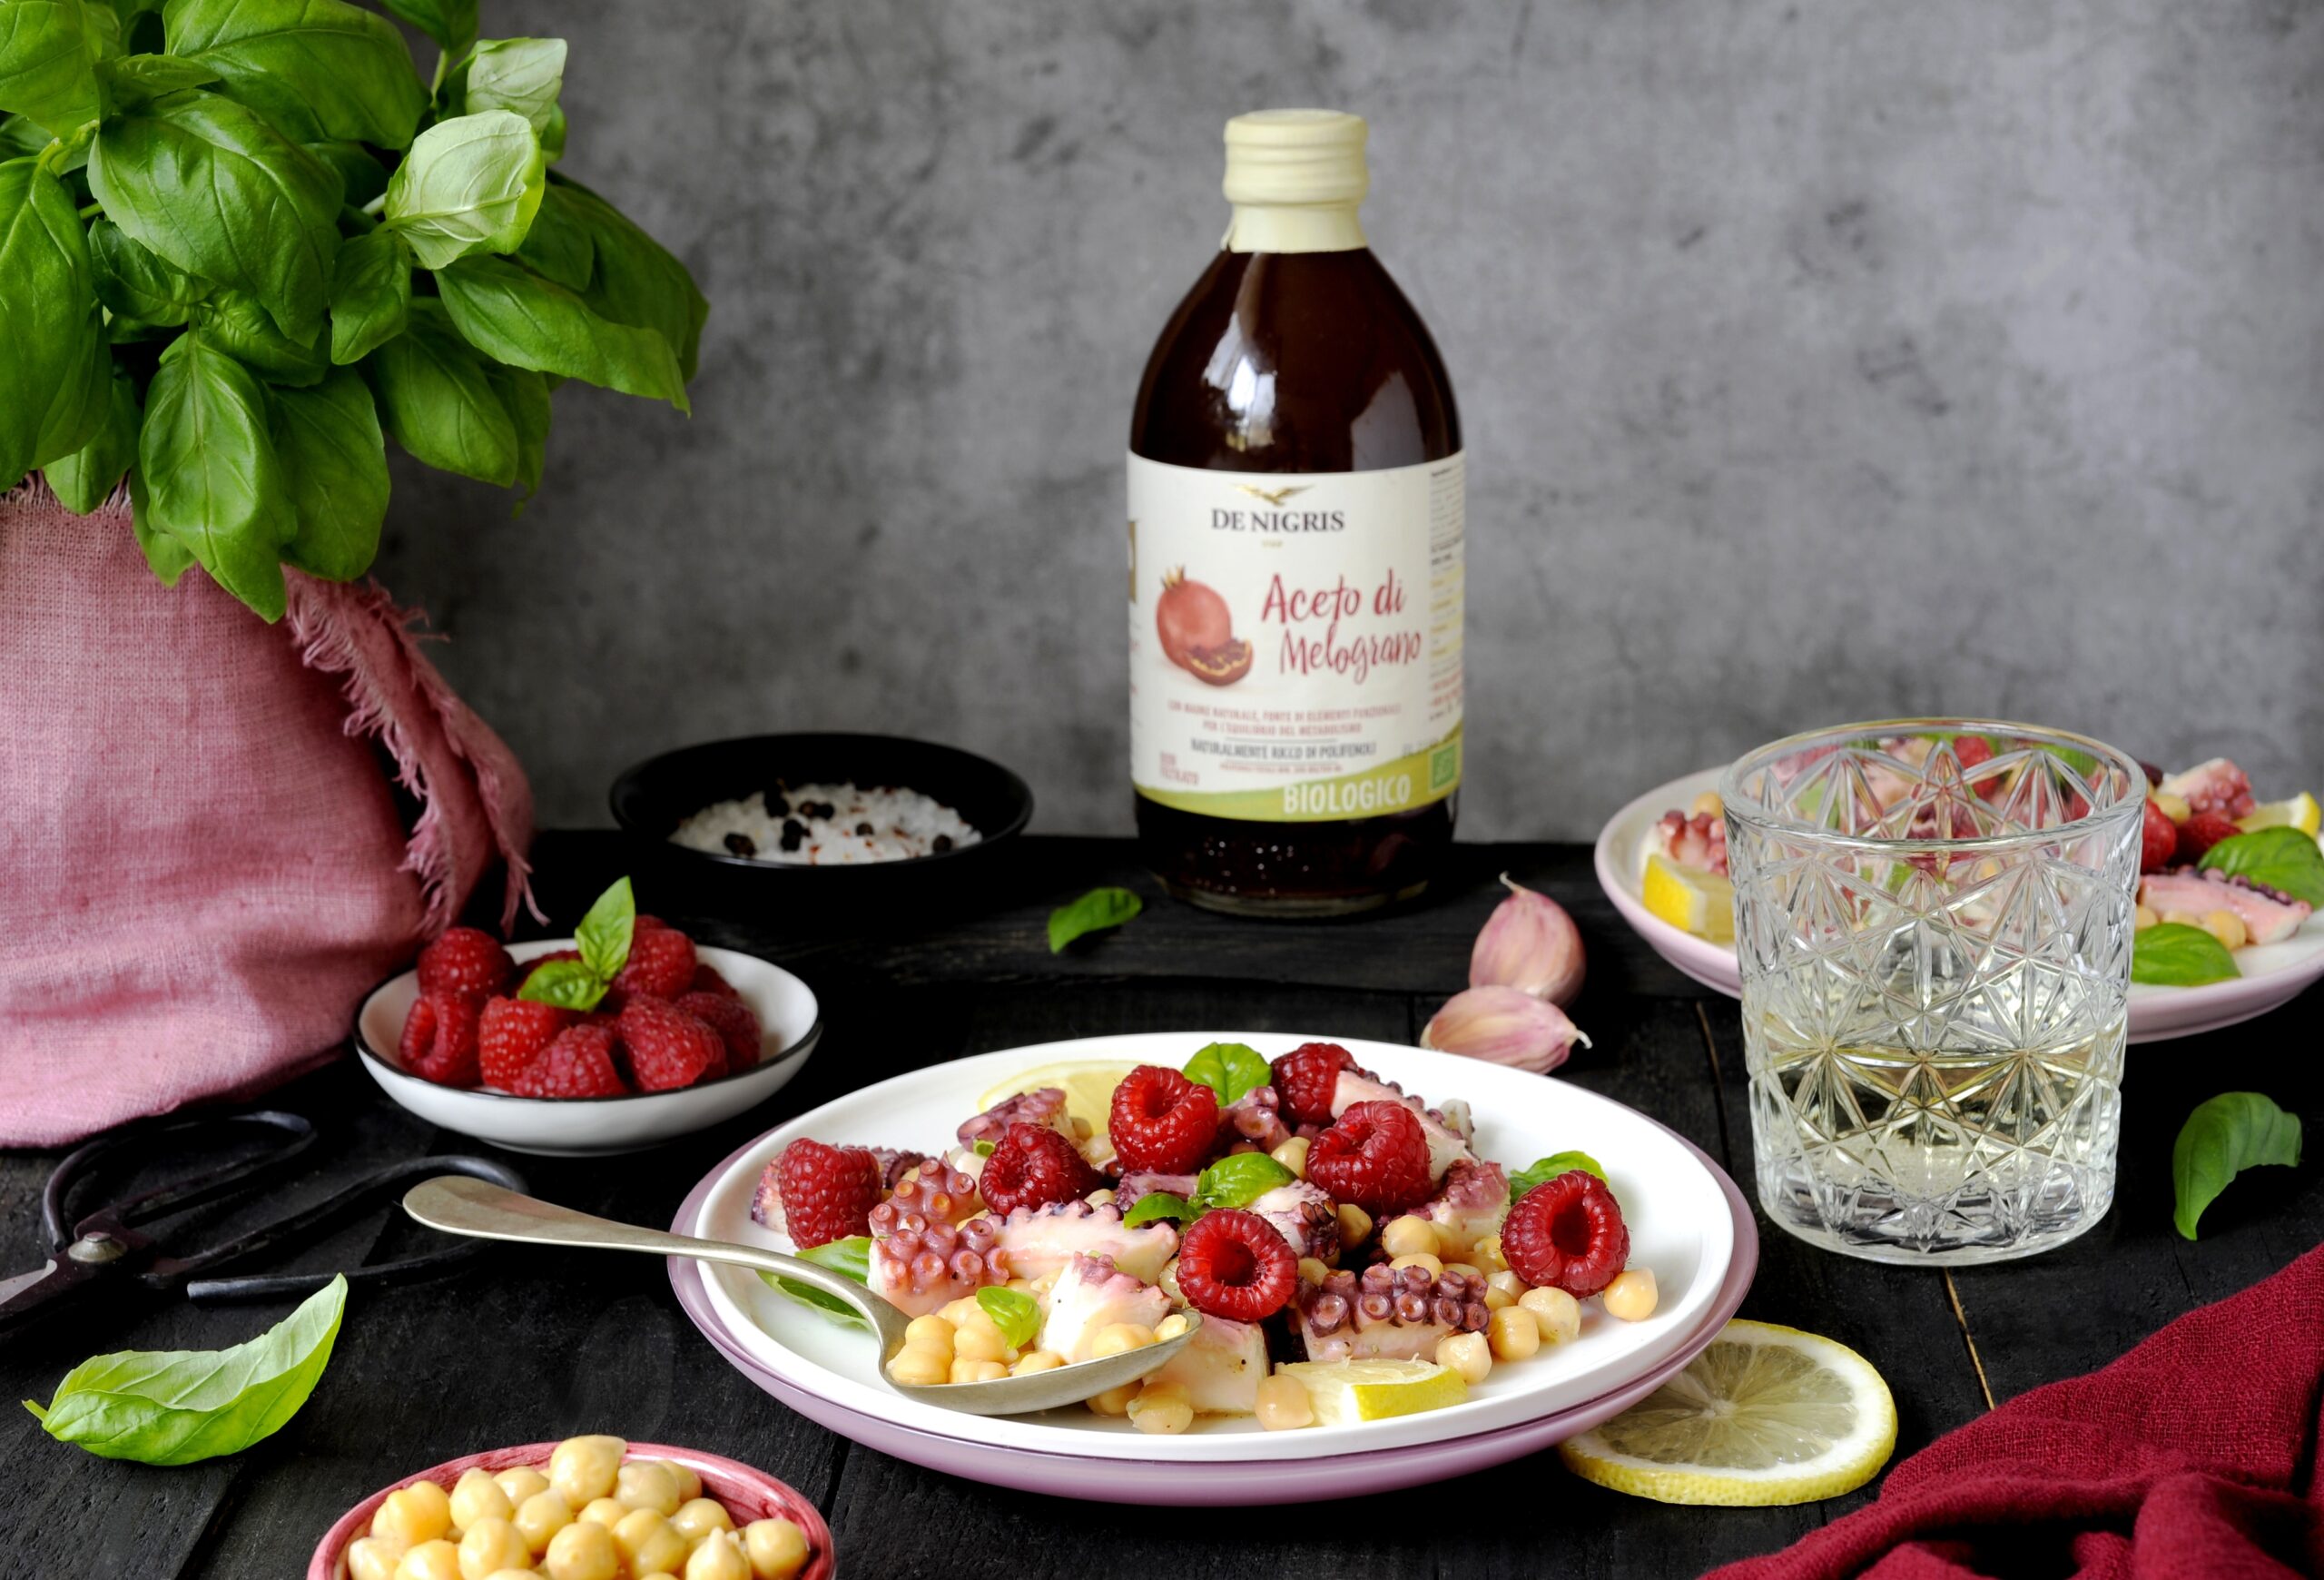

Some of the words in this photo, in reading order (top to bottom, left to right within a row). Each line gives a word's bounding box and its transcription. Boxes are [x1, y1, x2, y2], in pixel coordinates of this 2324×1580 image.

[1212, 509, 1245, 530] DE
[1251, 510, 1345, 533] NIGRIS
[1261, 572, 1362, 625] Aceto
[1374, 567, 1407, 617] di
[1280, 621, 1422, 685] Melograno
[1191, 738, 1268, 759] NATURALMENTE
[1272, 746, 1302, 760] RICCO
[1305, 745, 1316, 759] DI
[1319, 742, 1377, 759] POLIFENOLI
[1283, 775, 1411, 815] BIOLOGICO
